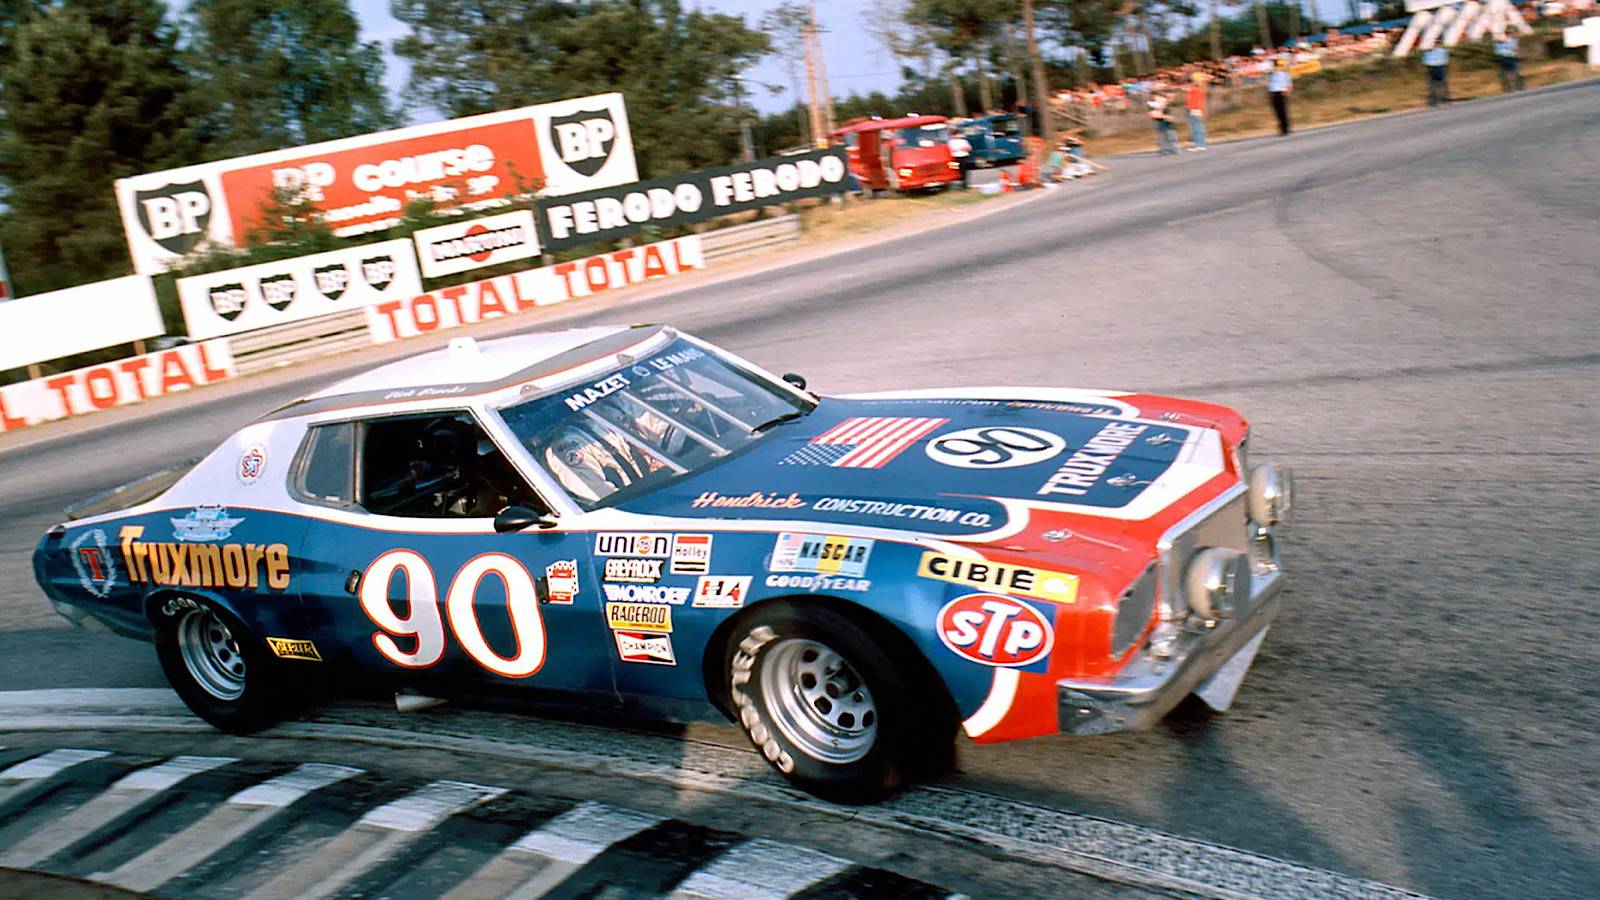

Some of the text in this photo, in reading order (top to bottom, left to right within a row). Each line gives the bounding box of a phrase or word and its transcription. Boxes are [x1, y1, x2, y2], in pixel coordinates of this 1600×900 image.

[554, 118, 614, 163] BP
[142, 191, 211, 241] BP
[547, 183, 702, 239] FERODO
[710, 155, 845, 206] FERODO
[377, 241, 696, 339] TOTAL TOTAL
[47, 343, 228, 417] TOTAL
[564, 373, 631, 412] MAZET
[934, 428, 1054, 465] 90
[1036, 421, 1149, 496] TRUXMORE
[690, 490, 993, 528] Hendrick CONSTRUCTION CO.
[118, 525, 291, 590] Truxmore
[674, 545, 708, 560] Holley
[798, 541, 868, 564] NASCAR
[765, 574, 871, 592] GOODYEAR
[358, 548, 548, 679] 90
[946, 601, 1043, 659] STP
